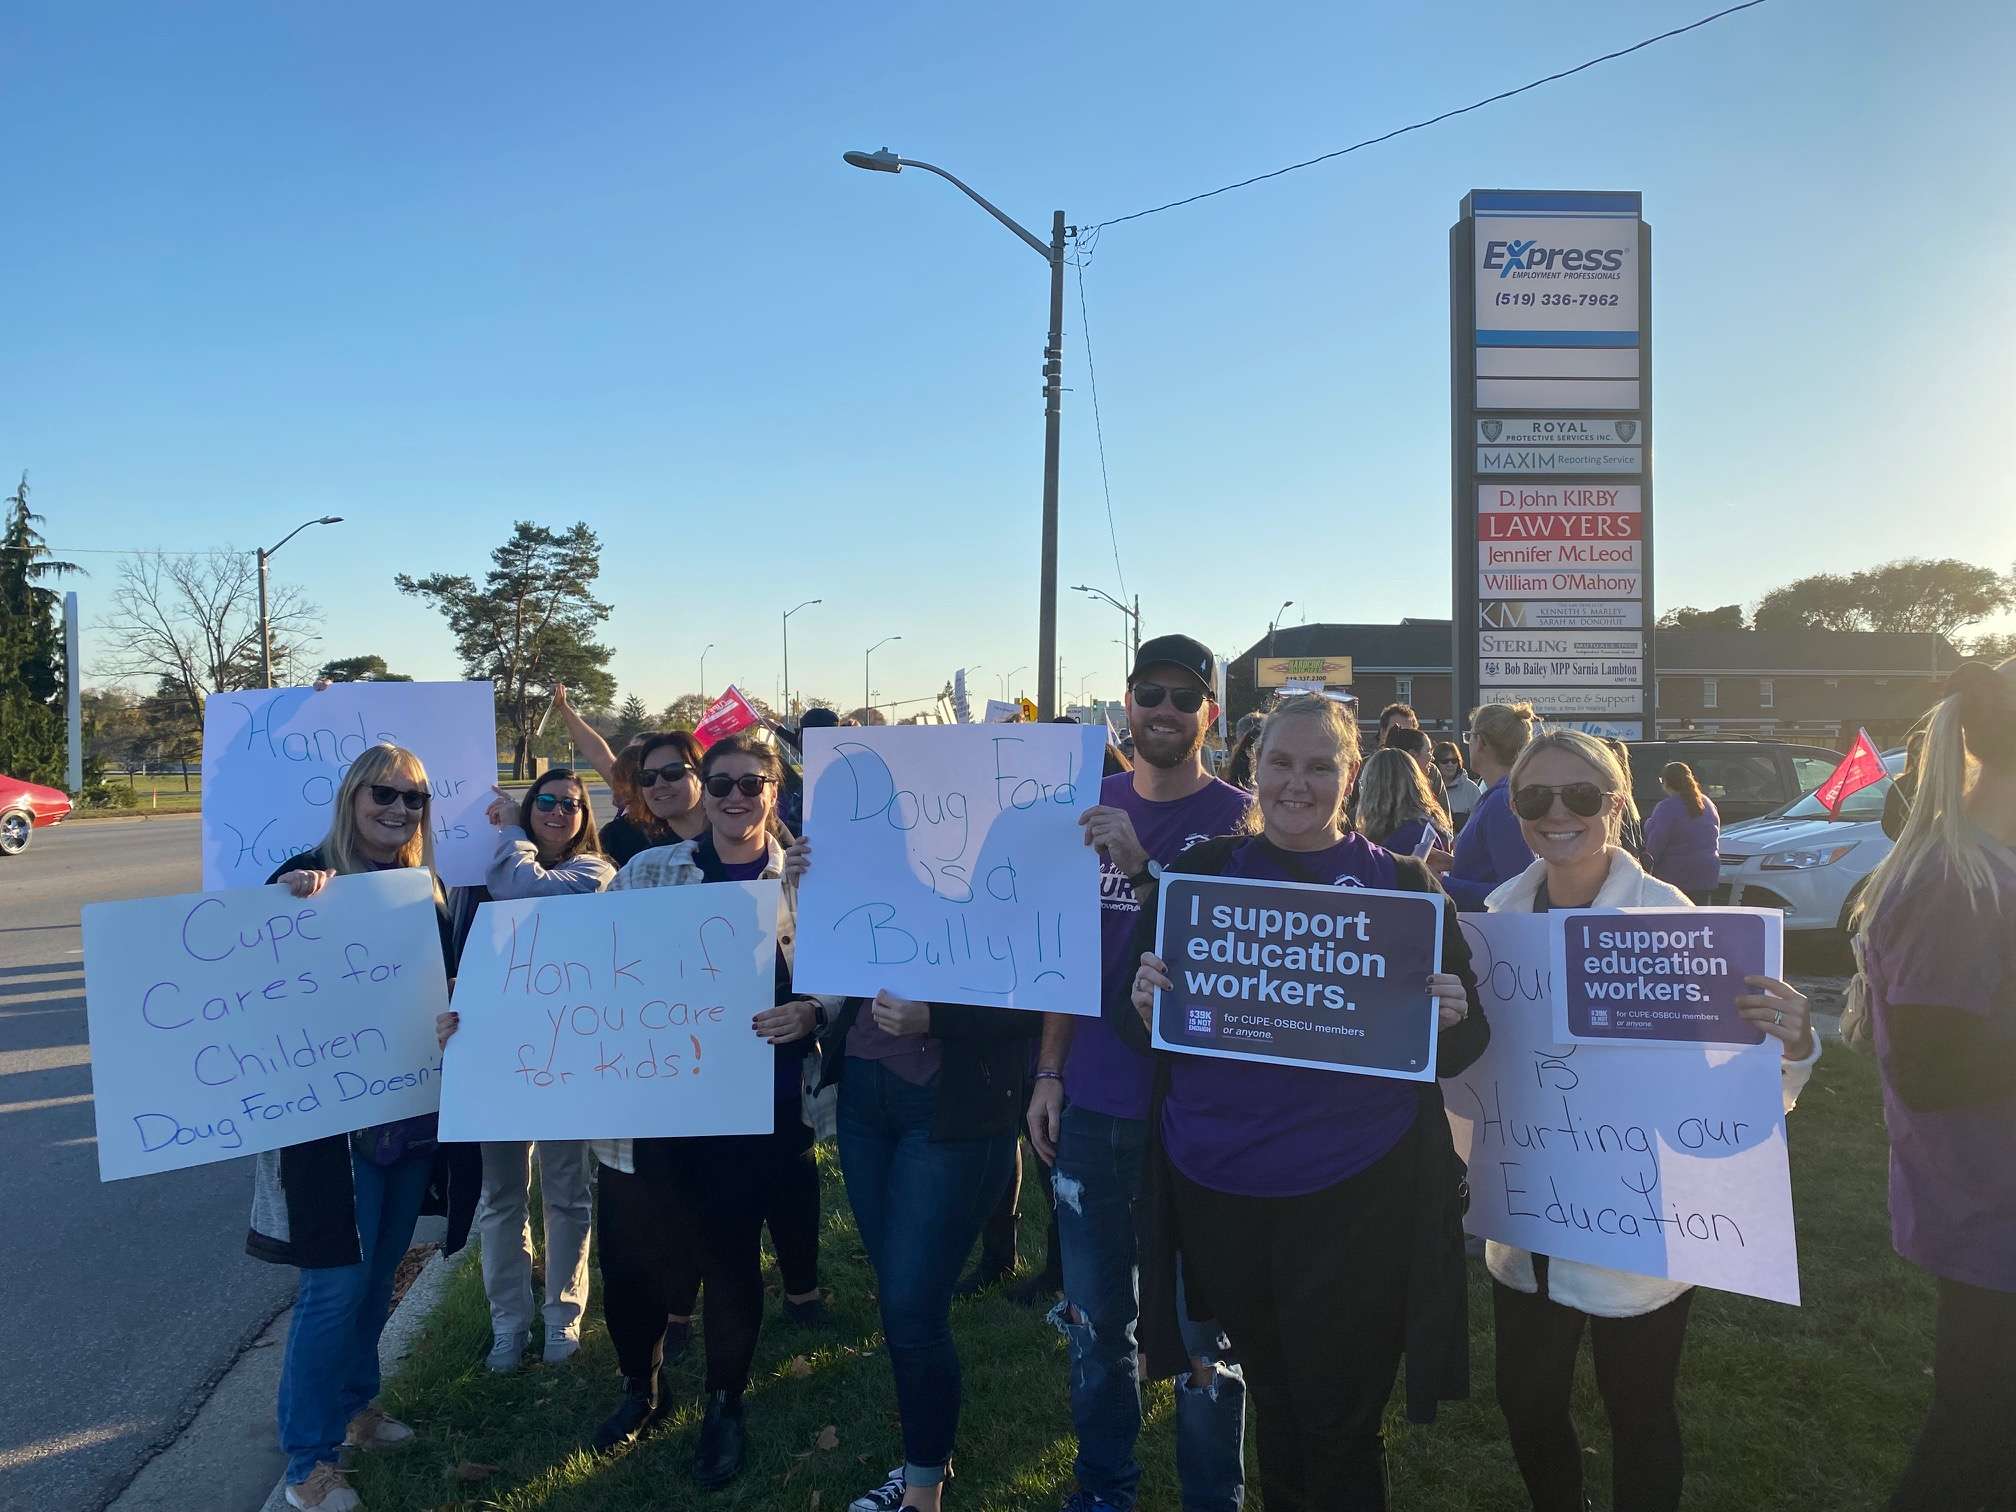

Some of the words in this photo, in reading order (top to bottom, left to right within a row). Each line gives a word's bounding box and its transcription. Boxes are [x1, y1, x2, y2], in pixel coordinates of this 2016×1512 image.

[1483, 239, 1624, 279] Express
[1512, 271, 1561, 279] EMPLOYMENT
[1564, 272, 1621, 280] PROFESSIONALS
[1495, 292, 1536, 307] (519)
[1541, 294, 1619, 307] 336-7962
[1506, 434, 1554, 442] PROTECTIVE
[1533, 422, 1588, 433] ROYAL
[1484, 453, 1555, 469] MAXIM
[1558, 455, 1601, 465] Reporting
[1603, 456, 1634, 464] Service
[1519, 490, 1558, 509] John
[1563, 490, 1619, 506] KIRBY
[1490, 515, 1632, 537] LAWYERS
[1488, 545, 1552, 566] Jennifer
[1558, 545, 1633, 562] McLeod
[1483, 574, 1548, 591] William
[1552, 574, 1636, 595] O'Mahony
[1540, 608, 1580, 616] KENNETH
[1481, 635, 1568, 653] STERLING
[1504, 662, 1521, 675] Bob
[1523, 662, 1548, 678] Bailey
[1550, 663, 1570, 675] MPP
[1572, 662, 1599, 675] Sarnia
[1601, 662, 1637, 675] Lambton
[1515, 695, 1556, 703] Seasons
[1557, 695, 1581, 703] Care
[1583, 695, 1593, 703] &
[1594, 694, 1635, 708] Support
[430, 777, 467, 800] ur
[833, 742, 969, 862] Doug
[991, 737, 1077, 811] Ford
[224, 818, 314, 869] Hum
[912, 848, 974, 904] is
[986, 856, 1018, 904] a
[182, 898, 322, 963] Cupe
[1190, 895, 1200, 926] I
[1211, 904, 1371, 942] support
[1583, 926, 1590, 949] I
[1599, 926, 1714, 953] support
[503, 913, 645, 996] Honk
[678, 916, 735, 982] if
[1187, 932, 1386, 978] education
[1583, 950, 1728, 976] education
[142, 971, 320, 1030] Cares
[341, 943, 403, 985] for
[1184, 969, 1356, 1011] workers.
[1584, 976, 1710, 1002] workers.
[1188, 1018, 1197, 1026] IS
[1197, 1019, 1212, 1027] NOT
[1189, 1009, 1212, 1021] $39K
[1223, 1013, 1239, 1024] for
[1241, 1014, 1312, 1031] CUPE-OSBCU
[1315, 1024, 1365, 1038] members
[1616, 1010, 1627, 1018] for
[1629, 1011, 1681, 1020] CUPE-OSBCU
[1682, 1013, 1719, 1021] members
[546, 1004, 625, 1075] you
[639, 1000, 726, 1030] care
[1223, 1026, 1234, 1035] or
[1235, 1028, 1273, 1040] anyone.
[195, 1027, 388, 1086] Children
[515, 1044, 576, 1087] for
[1535, 1060, 1579, 1091] is
[133, 1113, 243, 1153] Doug
[241, 1083, 322, 1121] Ford
[1465, 1081, 1659, 1193] Hurting
[1677, 1117, 1750, 1149] our
[1500, 1162, 1745, 1247] Education
